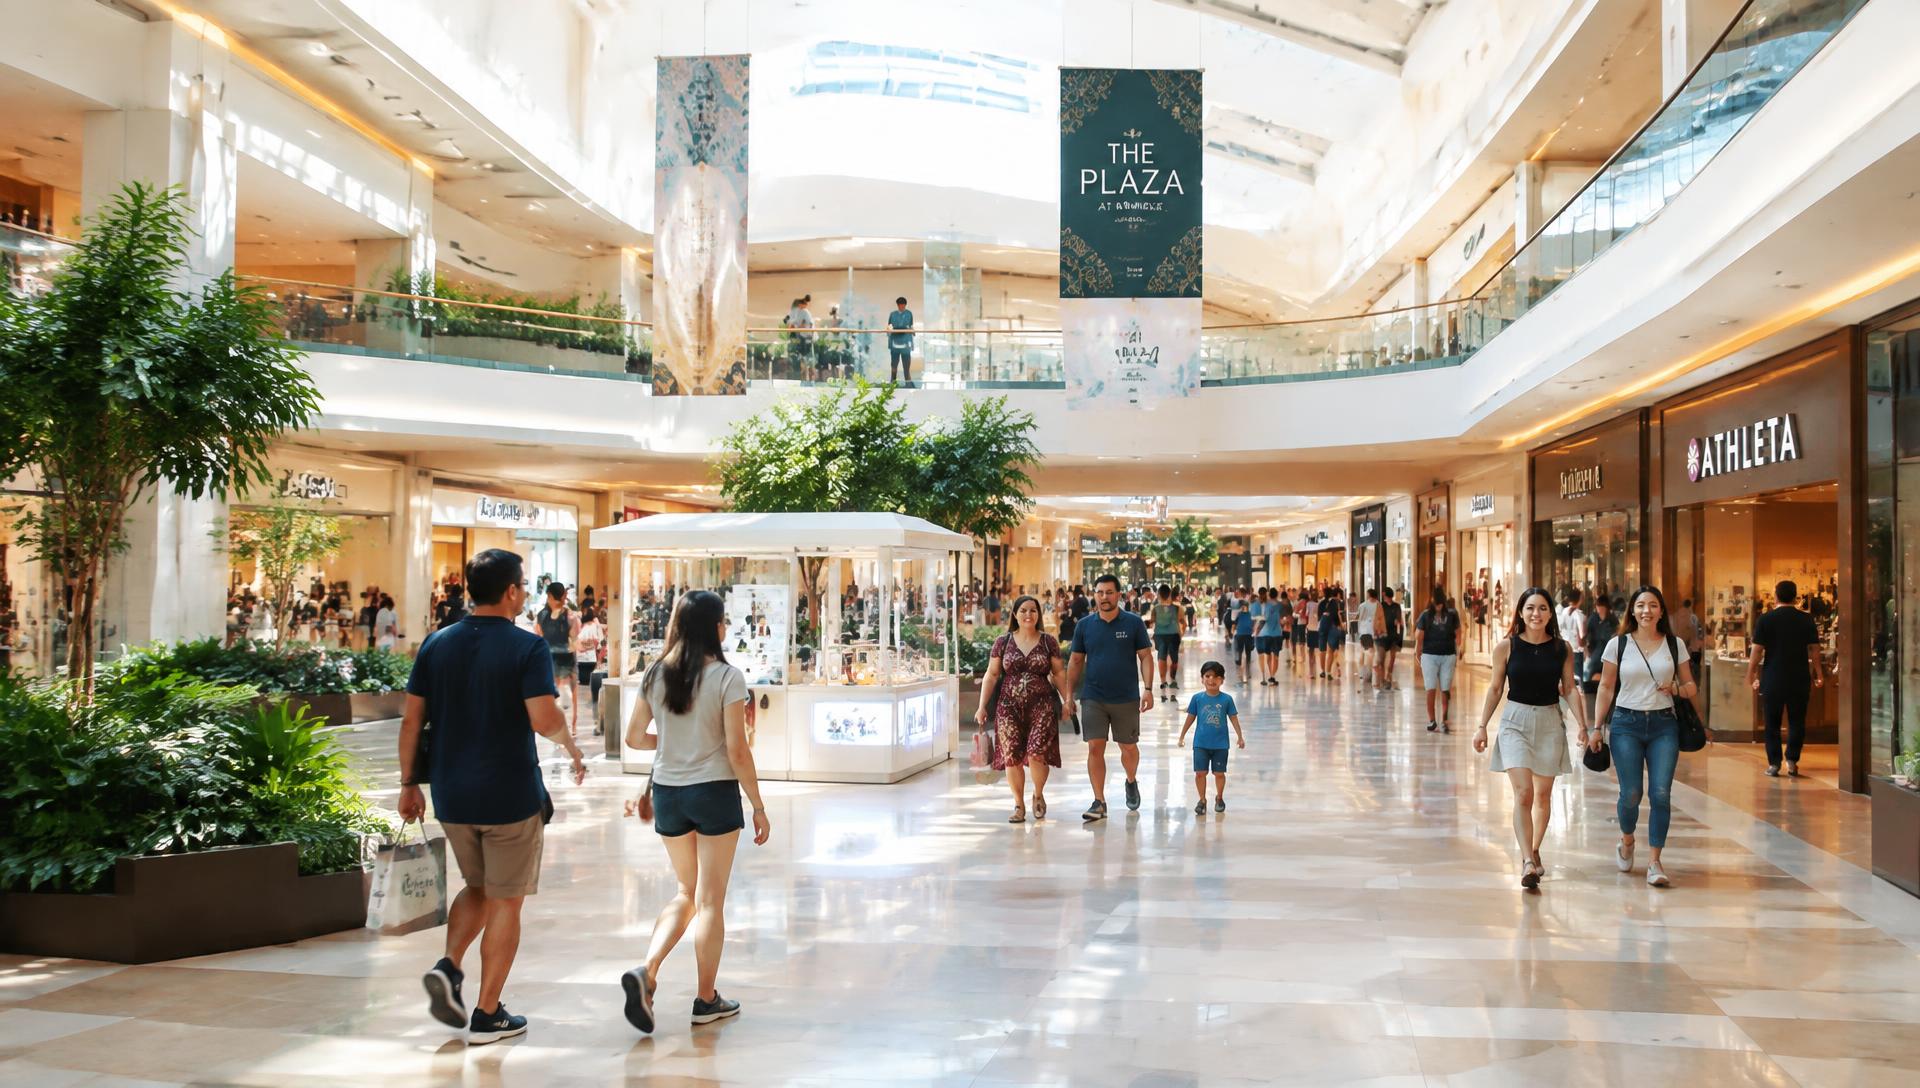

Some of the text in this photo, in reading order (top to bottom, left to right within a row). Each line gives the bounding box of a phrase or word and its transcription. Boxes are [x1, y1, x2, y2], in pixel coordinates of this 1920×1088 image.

[1107, 143, 1154, 164] THE
[1080, 168, 1185, 195] PLAZA
[1701, 412, 1797, 478] ATHLETA
